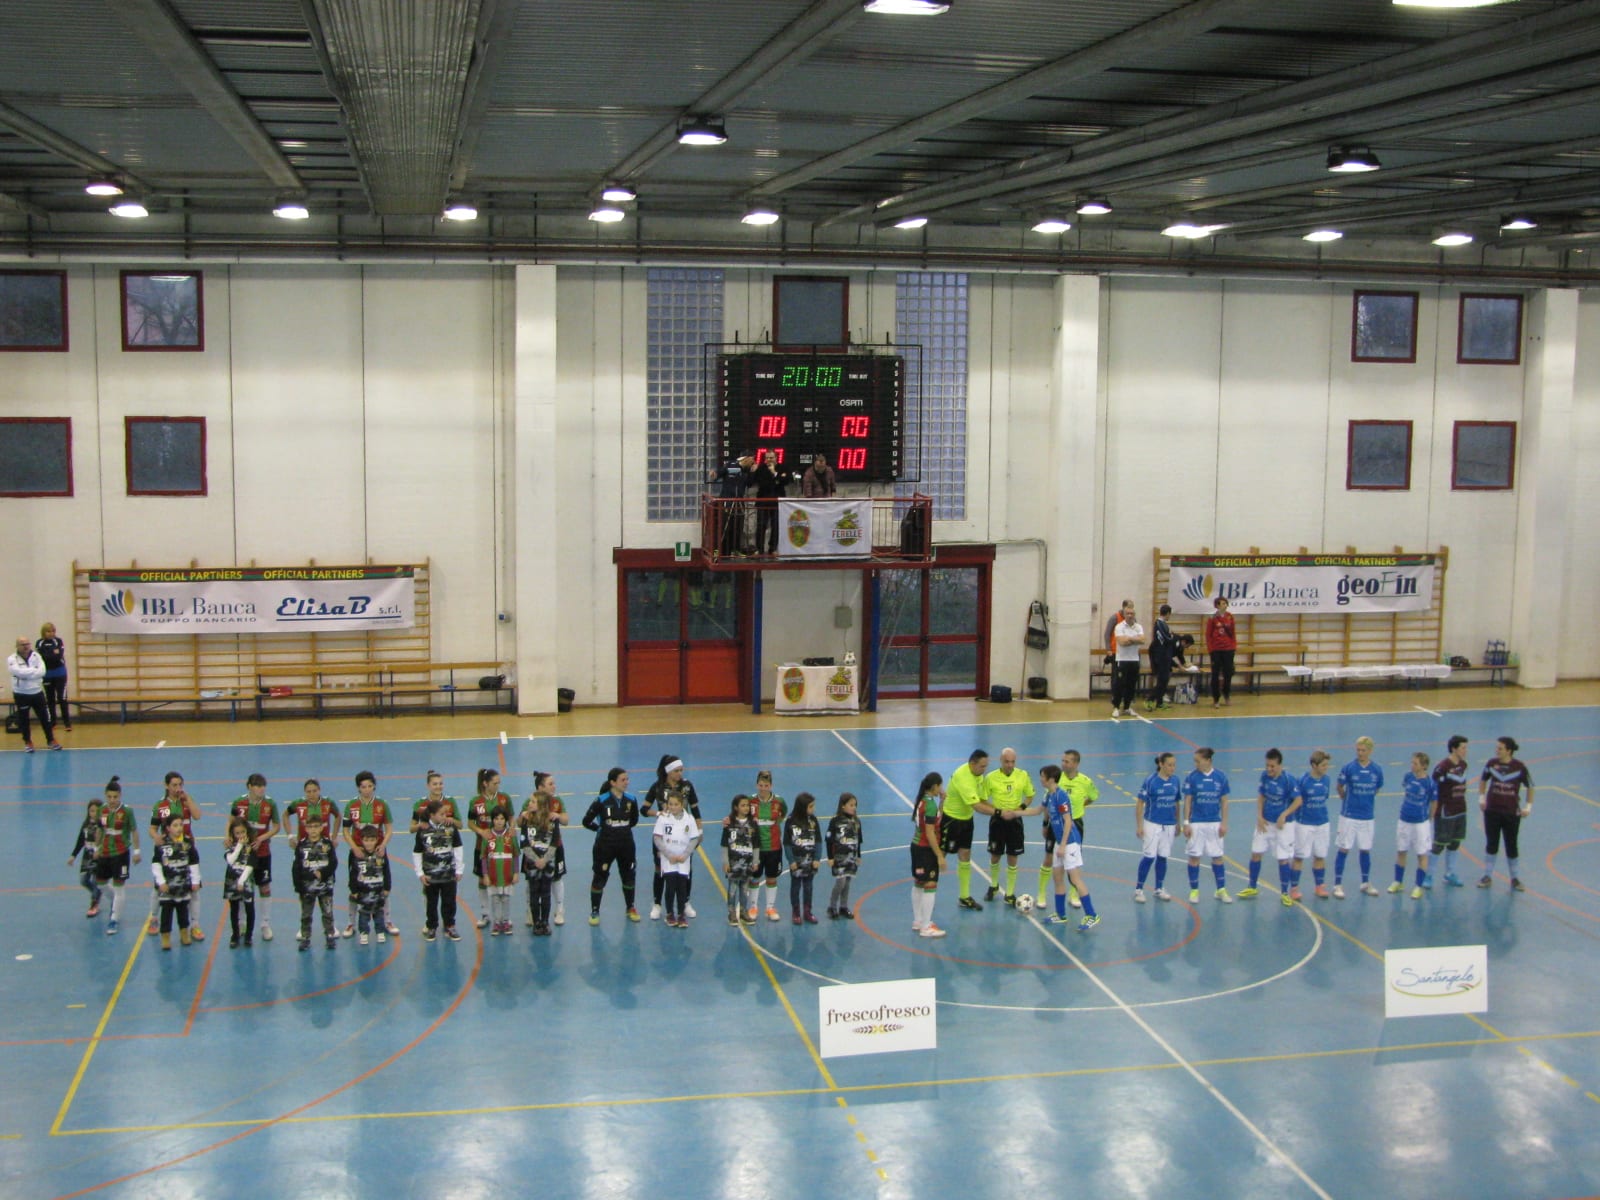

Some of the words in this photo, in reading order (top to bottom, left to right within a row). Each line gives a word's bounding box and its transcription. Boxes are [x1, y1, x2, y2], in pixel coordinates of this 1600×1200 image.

[782, 366, 842, 387] 20:00
[758, 399, 786, 407] LOCALI
[839, 399, 864, 407] OSPITI
[759, 416, 787, 437] 00
[832, 527, 863, 539] FERELLE
[1214, 558, 1252, 567] OFFICIAL
[1254, 557, 1298, 566] PARTNERS
[1314, 557, 1352, 566] OFFICIAL
[1354, 557, 1397, 566] PARTNERS
[140, 571, 187, 581] OFFICIAL
[190, 570, 243, 580] PARTNERS
[263, 570, 308, 580] OFFICIAL
[312, 569, 364, 579] PARTNERS
[1218, 582, 1256, 599] IBL
[1263, 581, 1319, 599] Banca
[1336, 571, 1417, 606] geoFin
[141, 598, 184, 616] IBL
[192, 597, 257, 616] Banca
[378, 604, 402, 615] s.r.l.
[664, 825, 673, 835] 12
[489, 841, 496, 849] 9
[826, 1004, 931, 1026] frescofresco
